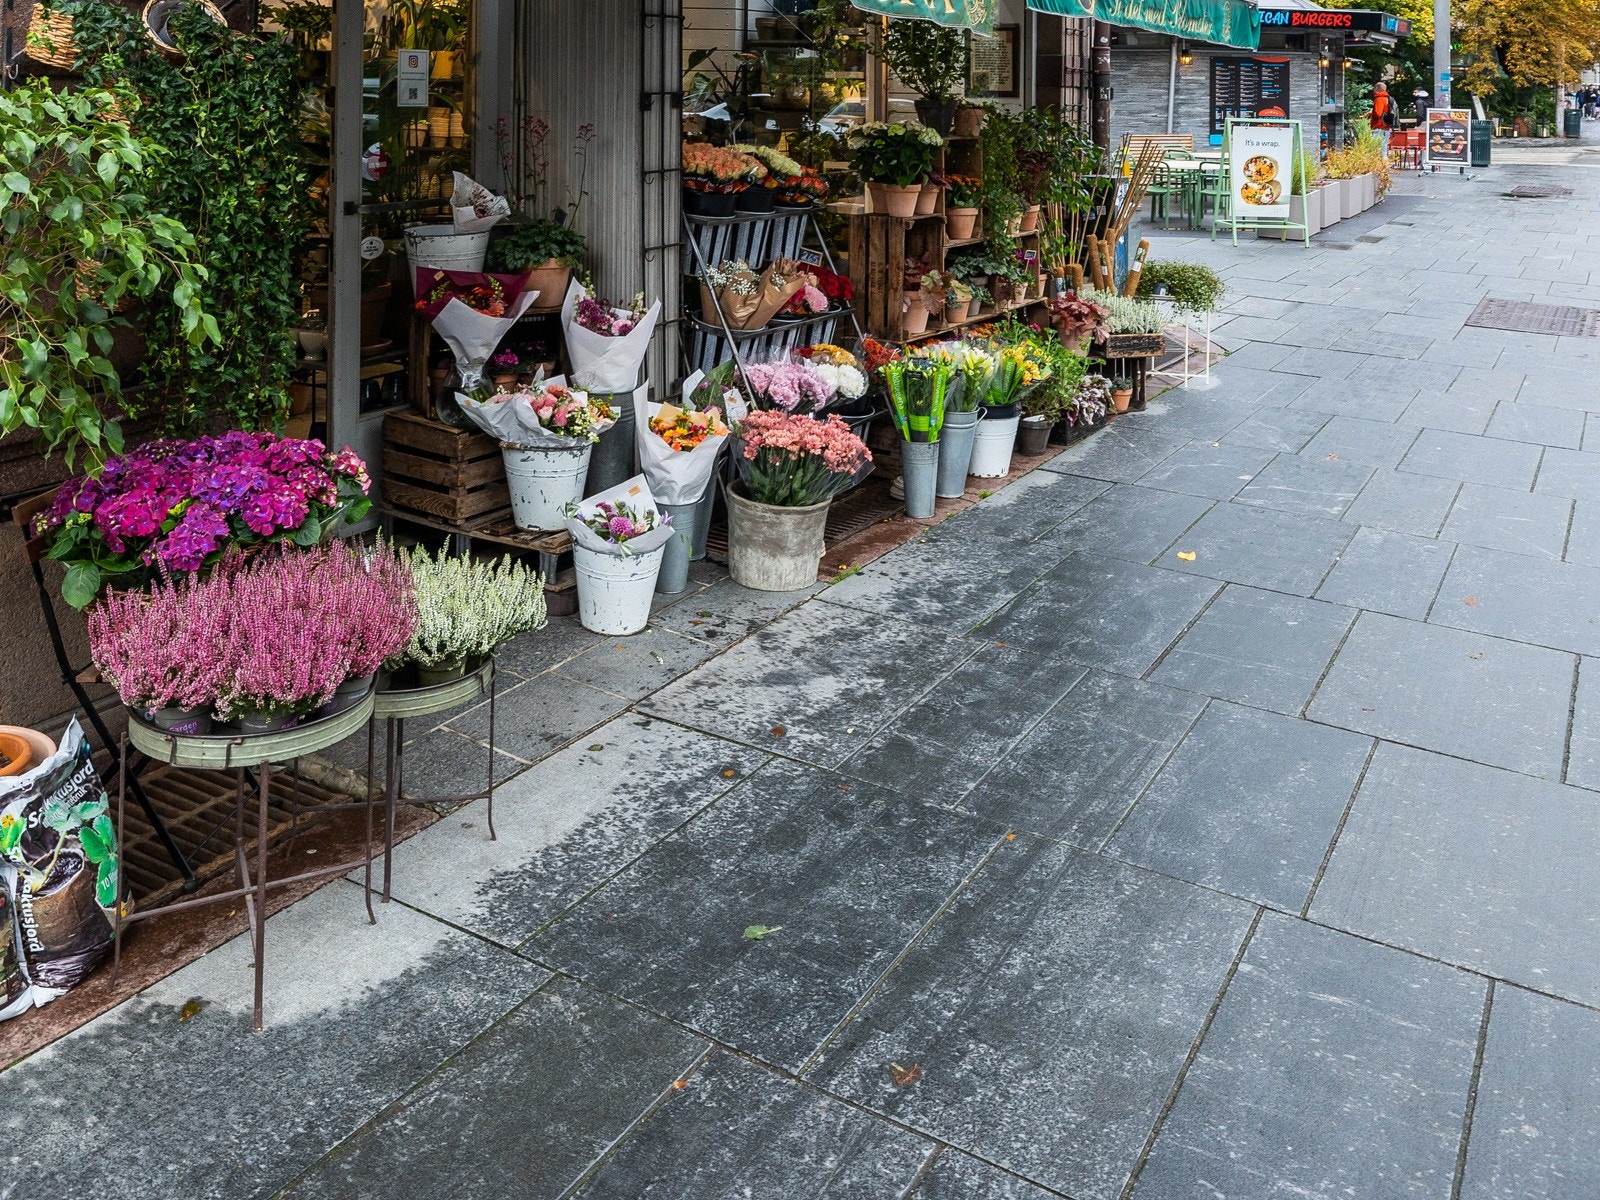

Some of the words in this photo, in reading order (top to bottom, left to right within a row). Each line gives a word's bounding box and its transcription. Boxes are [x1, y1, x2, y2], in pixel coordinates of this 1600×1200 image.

[1259, 10, 1289, 25] ICAN
[1291, 12, 1352, 27] BURGERS
[1245, 138, 1255, 147] It's
[1261, 141, 1280, 149] wrap.
